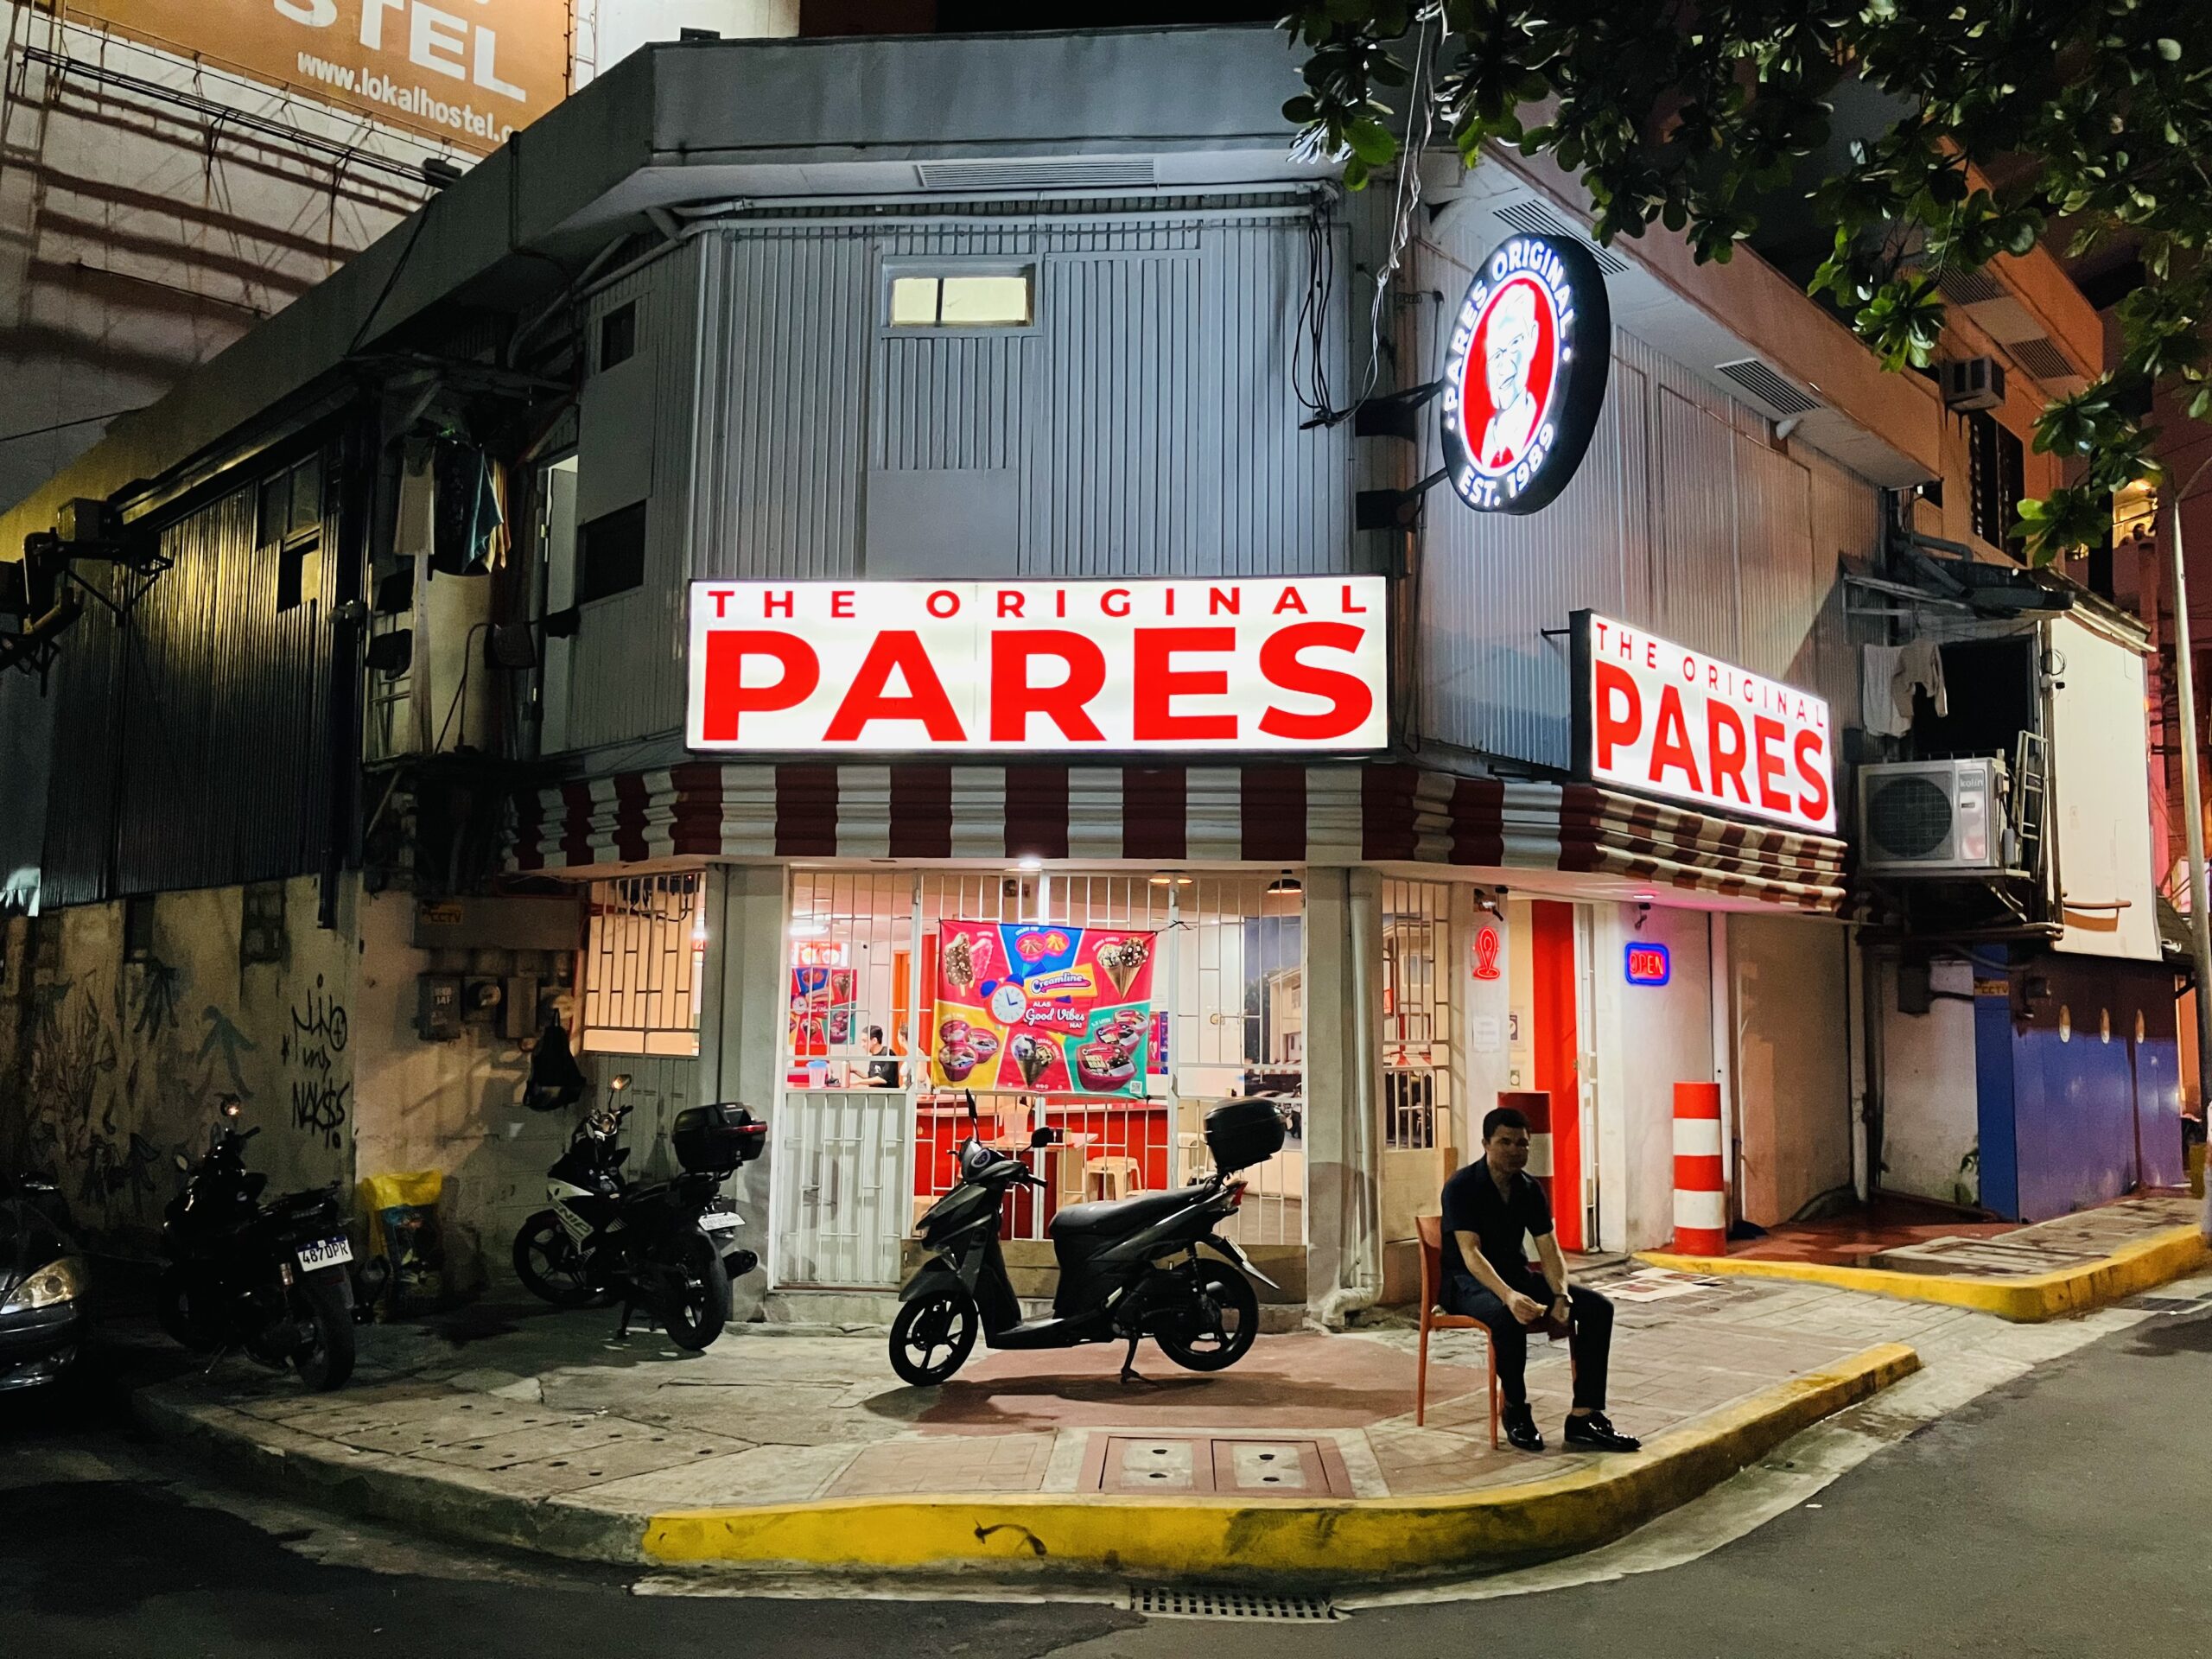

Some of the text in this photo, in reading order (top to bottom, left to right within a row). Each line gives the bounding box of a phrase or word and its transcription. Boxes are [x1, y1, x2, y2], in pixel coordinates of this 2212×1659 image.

[1444, 239, 1575, 412] PARES ORIGINAL
[1459, 423, 1554, 508] EST. 1989
[708, 584, 1367, 619] THE ORIGINAL
[702, 620, 1374, 743] PARES
[1597, 621, 1825, 728] THE ORIGINAL
[1595, 658, 1829, 822] PARES
[1959, 778, 1984, 788] kolin
[430, 912, 461, 923] CCTV
[1630, 952, 1664, 975] OPEN
[1031, 971, 1084, 994] Creamline
[1981, 985, 2008, 995] CCTV
[1024, 1007, 1085, 1027] Good Vibes
[302, 1242, 348, 1264] 487DPR
